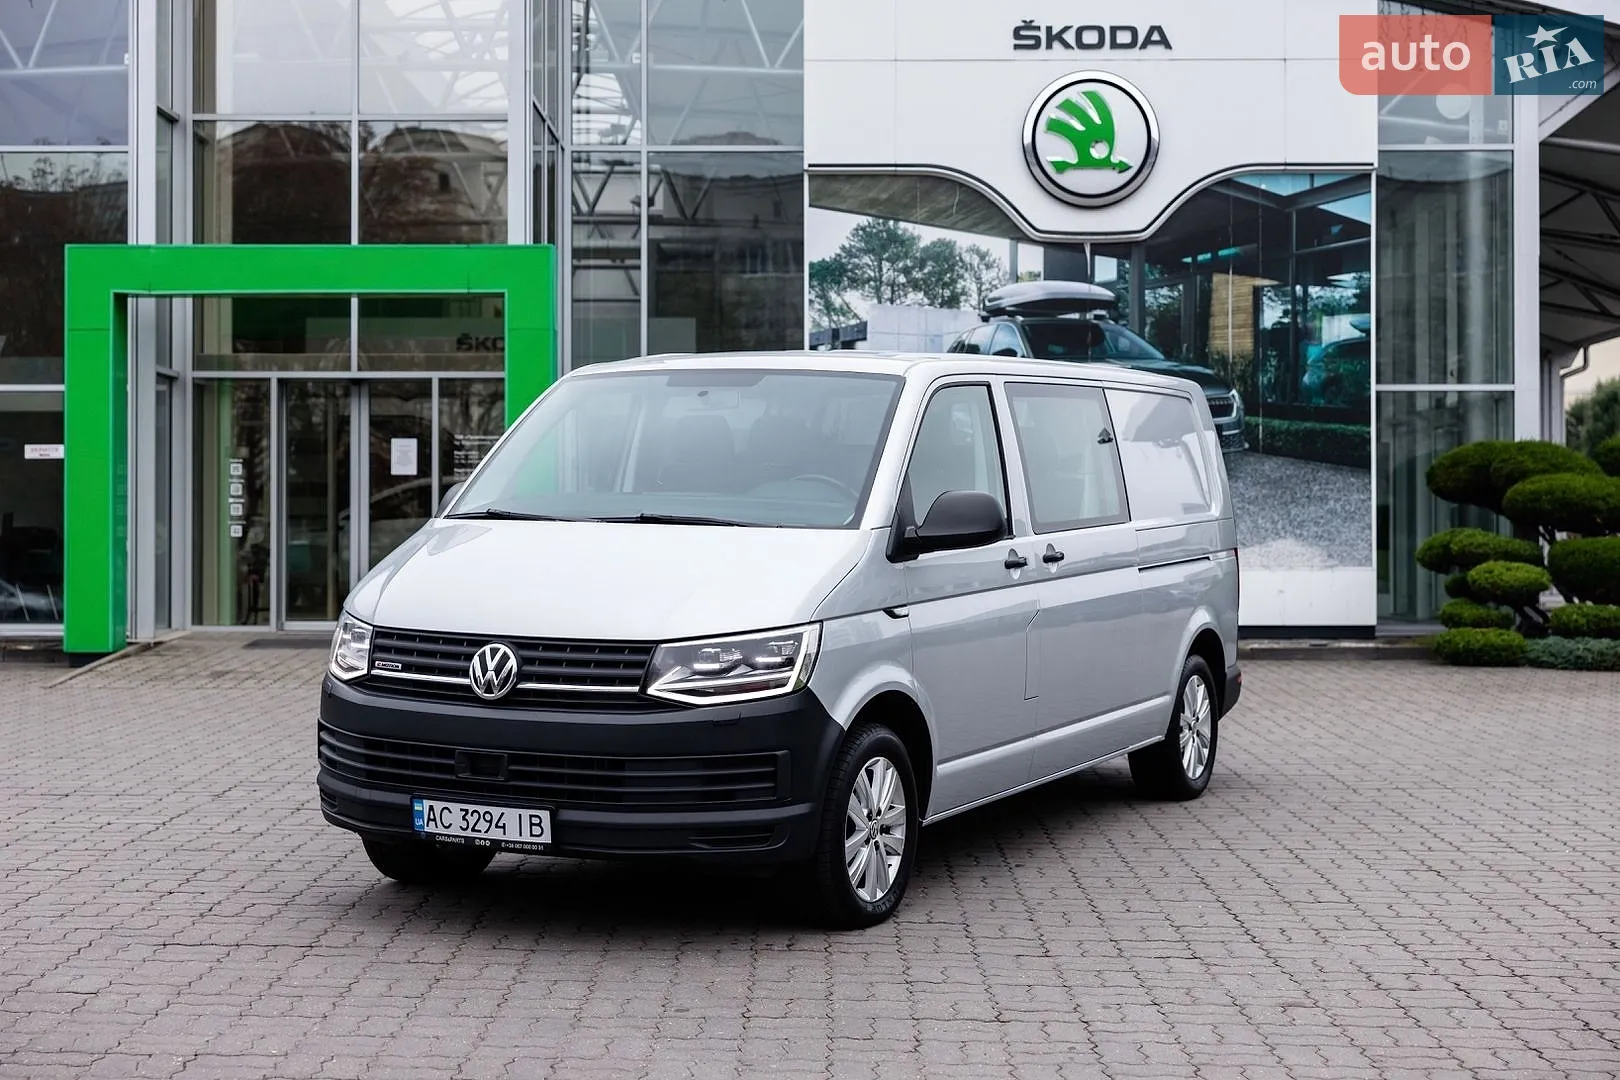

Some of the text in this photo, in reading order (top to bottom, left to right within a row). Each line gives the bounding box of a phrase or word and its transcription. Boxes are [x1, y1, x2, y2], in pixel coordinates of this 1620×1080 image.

[1013, 20, 1173, 50] ŠKODA
[425, 804, 453, 830] AC
[459, 807, 507, 836] 3294
